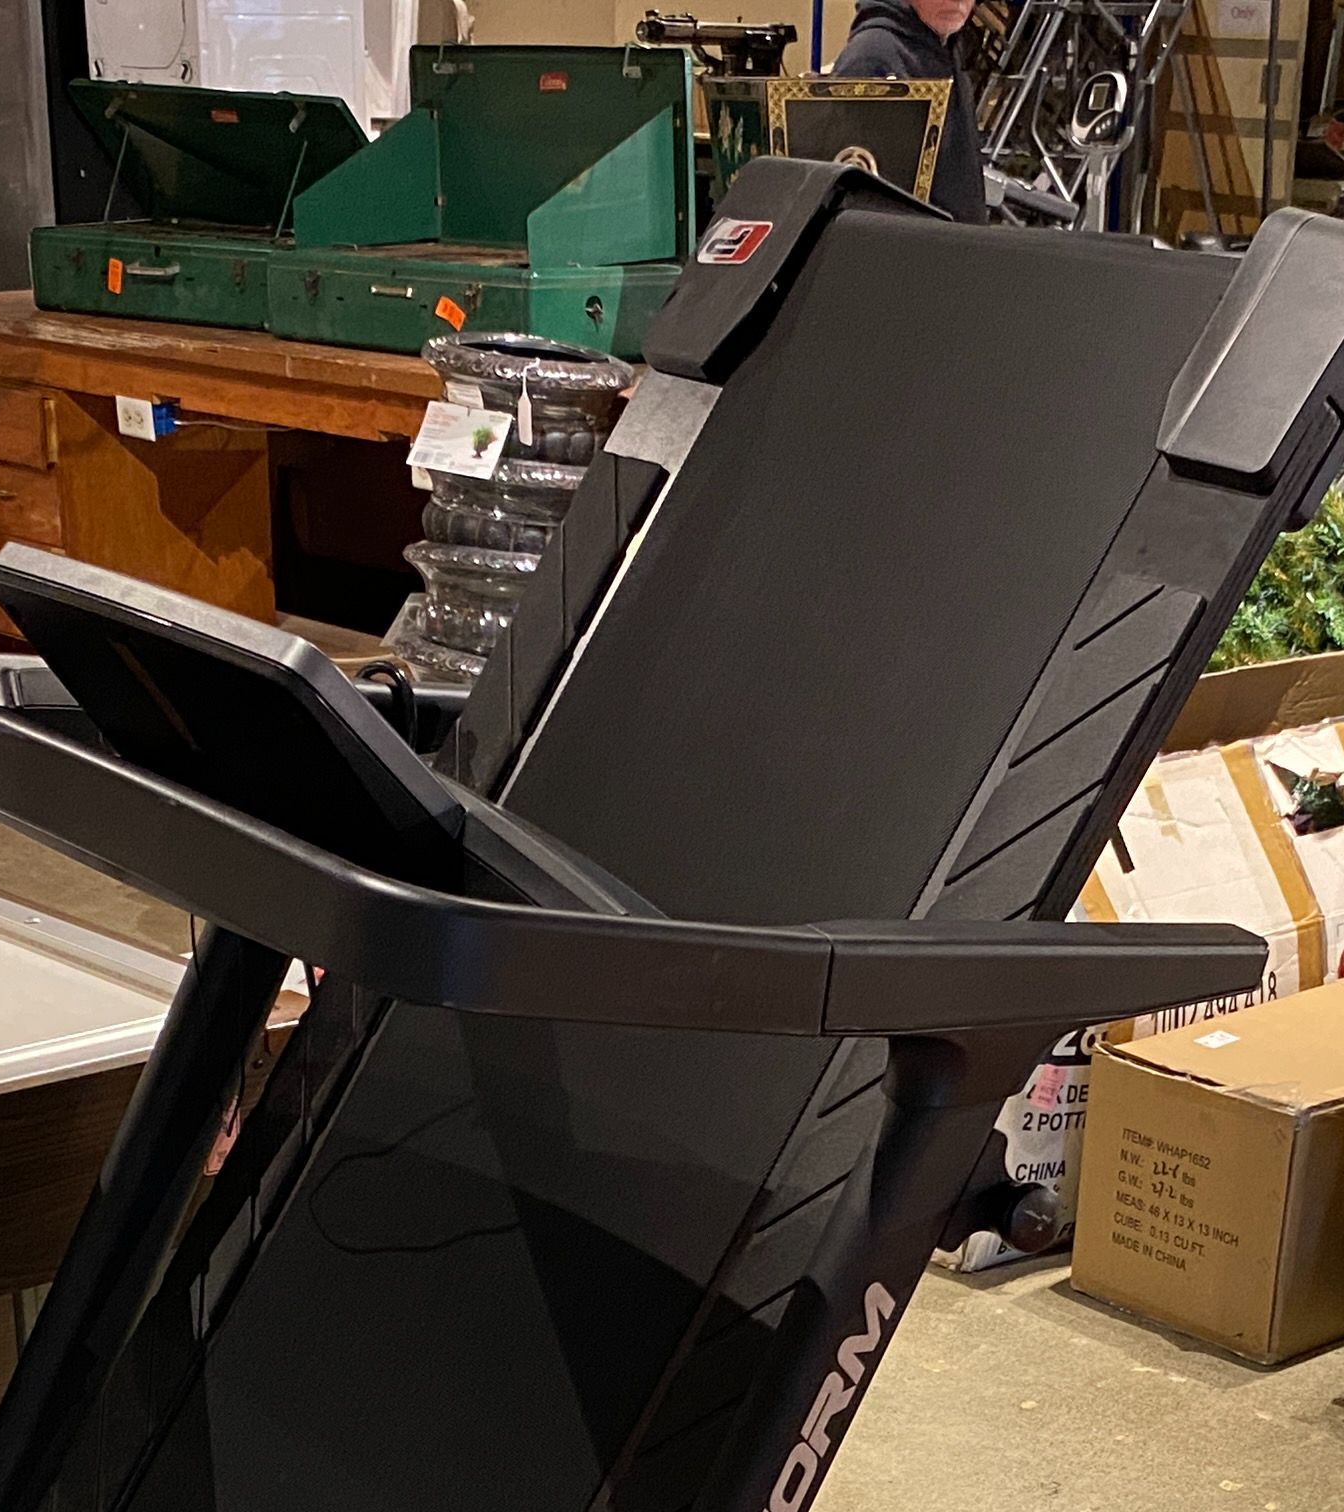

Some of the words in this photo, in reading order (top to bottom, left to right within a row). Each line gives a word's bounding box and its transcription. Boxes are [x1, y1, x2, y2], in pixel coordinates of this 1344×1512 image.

[1022, 1112, 1034, 1131] 2
[1037, 1111, 1086, 1131] POTT
[1157, 1140, 1212, 1170] WHAP1652
[1015, 1160, 1066, 1181] CHINA
[1212, 1226, 1239, 1248] INCH
[1112, 1232, 1140, 1252] MADE
[1155, 1248, 1187, 1271] CHINA
